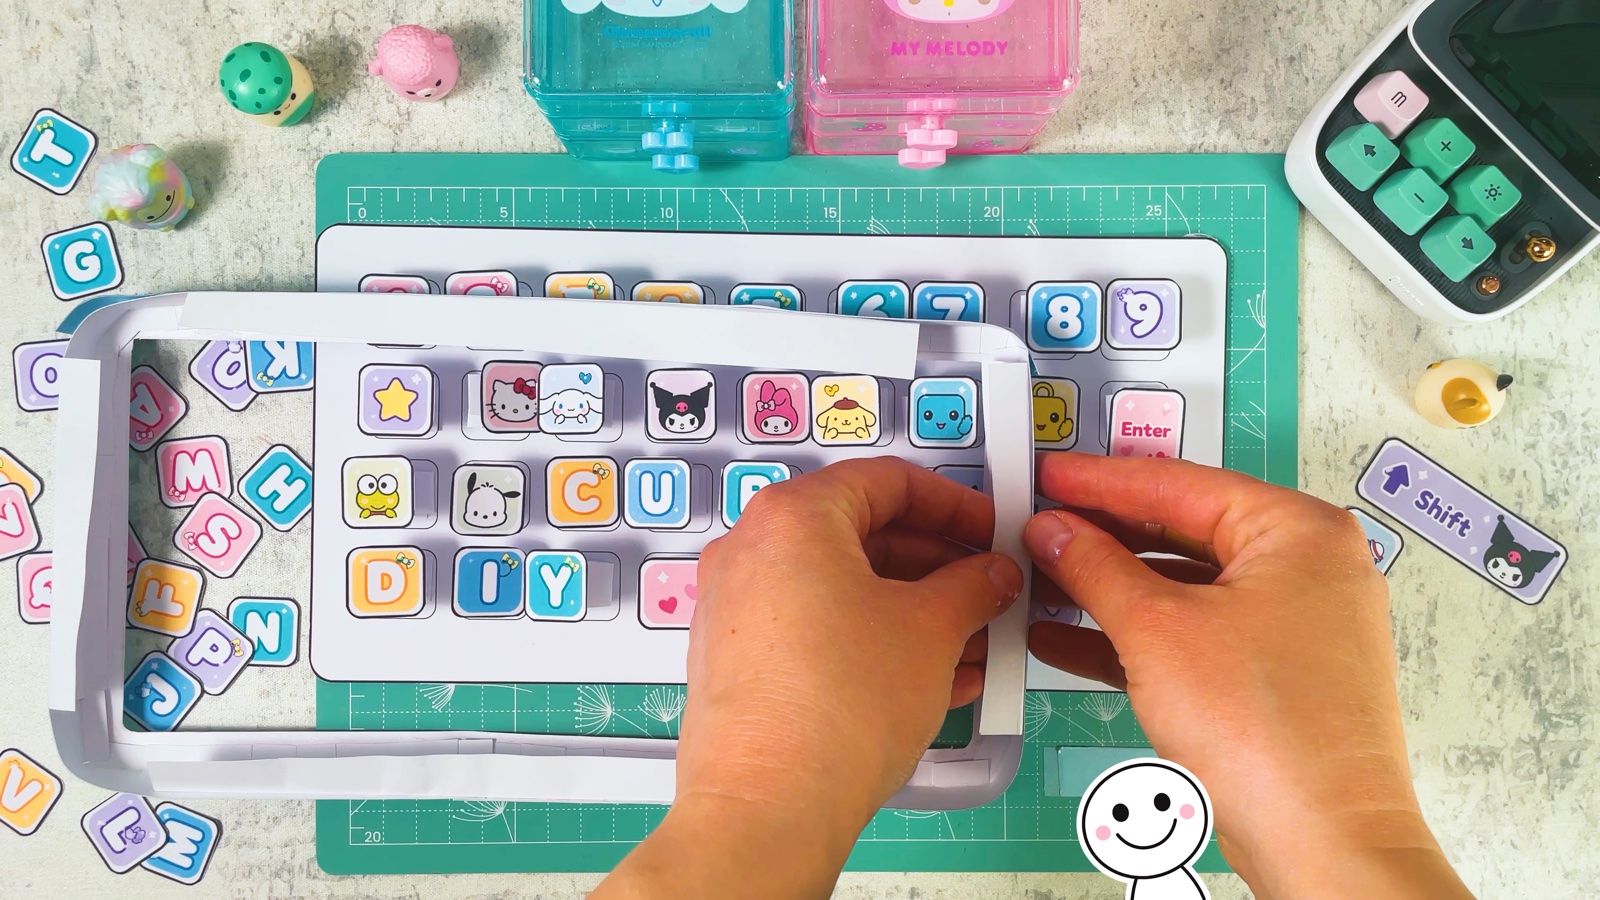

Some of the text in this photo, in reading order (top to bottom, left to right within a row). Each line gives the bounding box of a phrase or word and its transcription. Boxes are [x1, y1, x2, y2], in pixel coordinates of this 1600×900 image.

[890, 40, 1008, 56] MY MELODY
[29, 127, 75, 167] T
[357, 205, 1162, 219] 0 5 10 15 20 25
[61, 238, 103, 284] G
[1044, 293, 1084, 342] 8
[1124, 290, 1163, 338] 9
[1121, 421, 1172, 438] Enter
[256, 462, 308, 514] H
[561, 468, 676, 517] C U
[195, 512, 242, 559] S
[1414, 490, 1471, 538] Shift
[139, 577, 185, 618] F
[364, 557, 574, 609] D I Y
[185, 626, 234, 667] P
[244, 609, 282, 656] N
[146, 670, 182, 717] J
[0, 764, 45, 813] V
[99, 805, 142, 855] L
[364, 831, 381, 844] 20
